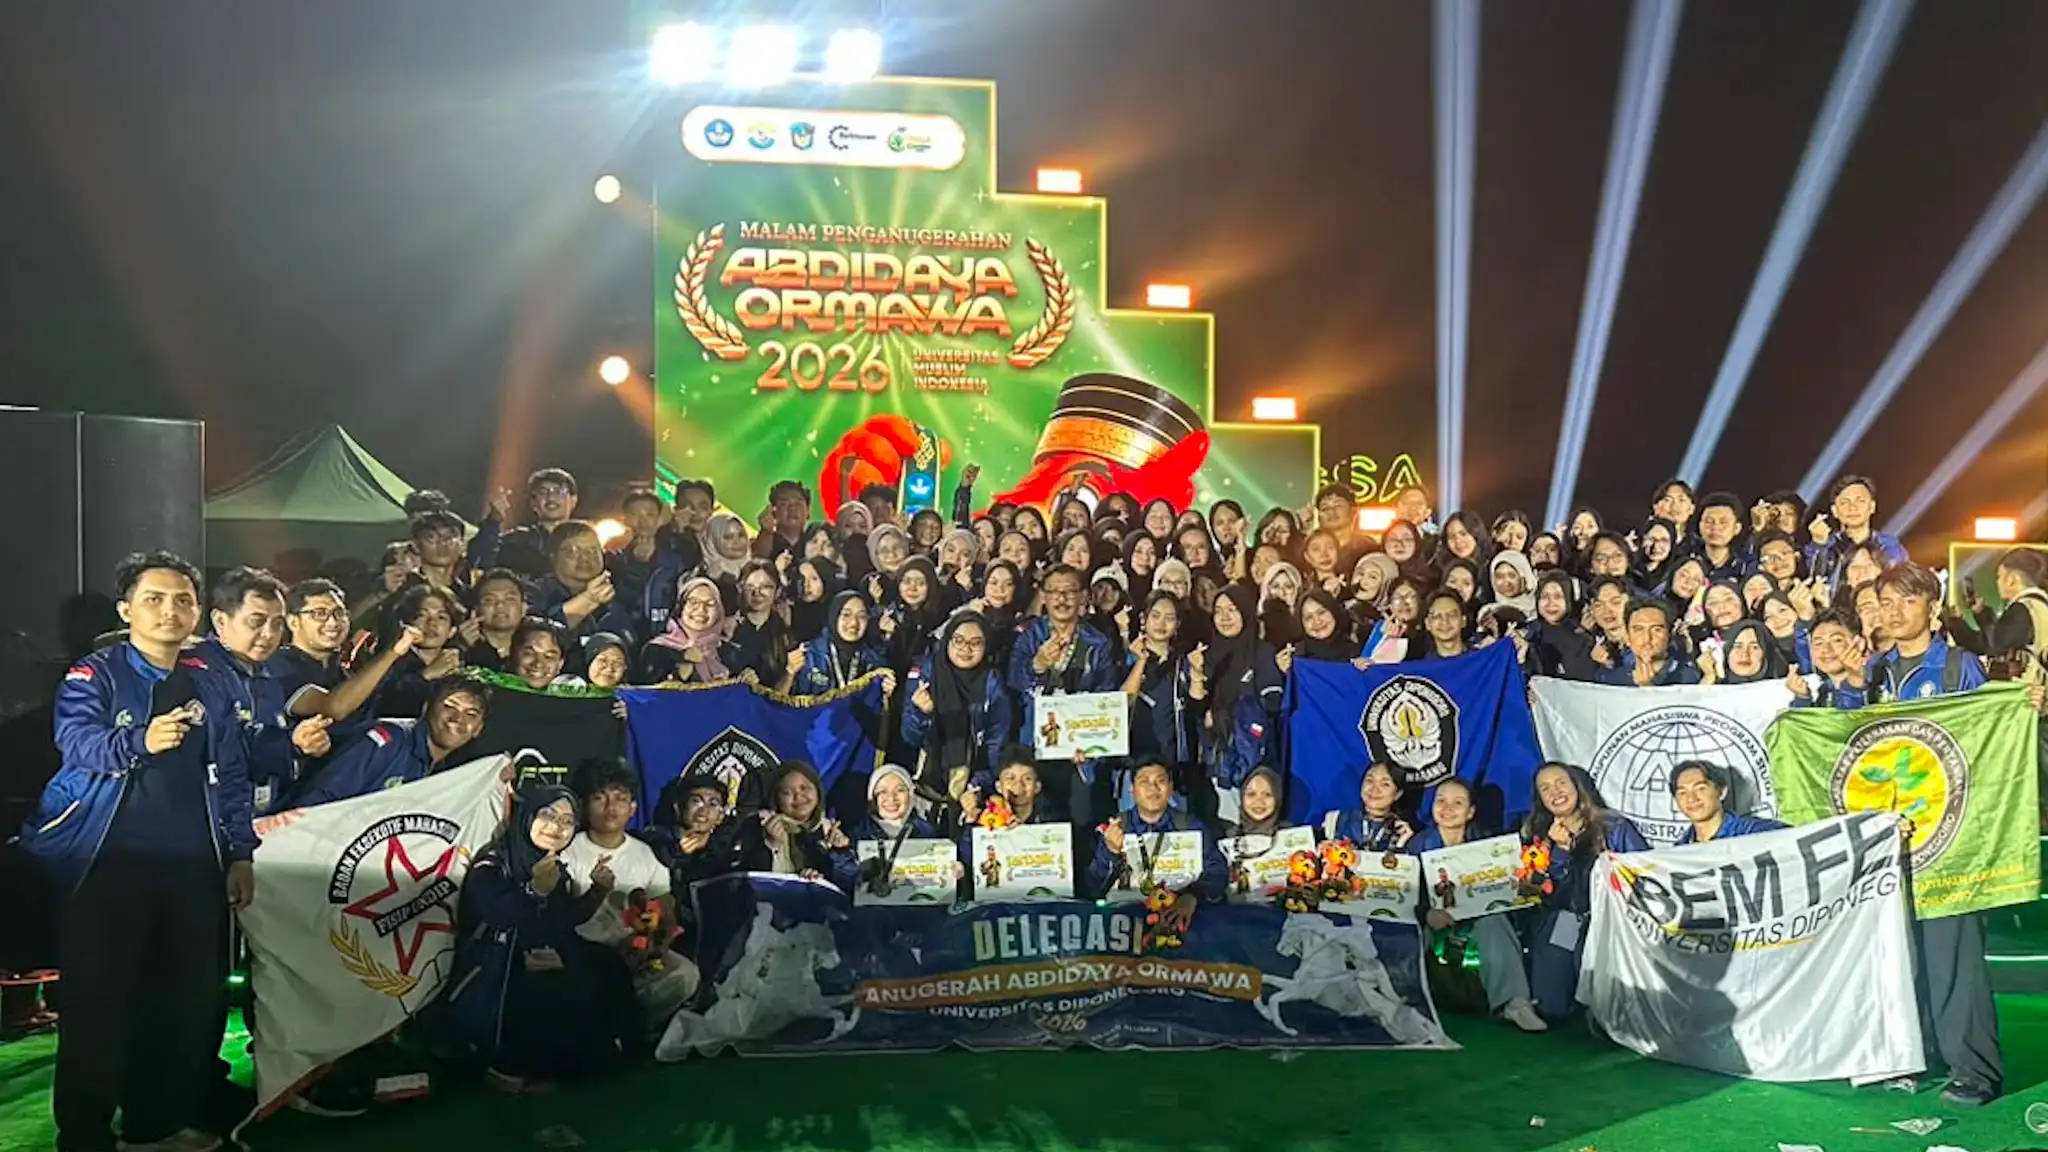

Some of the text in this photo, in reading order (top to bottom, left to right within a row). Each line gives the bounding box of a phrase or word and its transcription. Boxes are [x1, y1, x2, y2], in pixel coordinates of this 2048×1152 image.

[740, 221, 1012, 248] MALAM PENGANUGERAHAN
[720, 247, 1018, 302] ABDIDAYA
[734, 287, 1013, 336] ORMAWA
[756, 341, 890, 393] 2026
[911, 348, 1000, 365] UNIVERSITAS
[911, 362, 967, 377] MUSLIM
[911, 376, 990, 394] INDONESIA
[1705, 715, 1758, 758] PROGRAM
[973, 913, 1145, 962] DELEGASI
[865, 961, 1252, 1004] ANUGERAH ABDIDAYA ORMAWA
[929, 999, 1054, 1020] UNIVERSITAS
